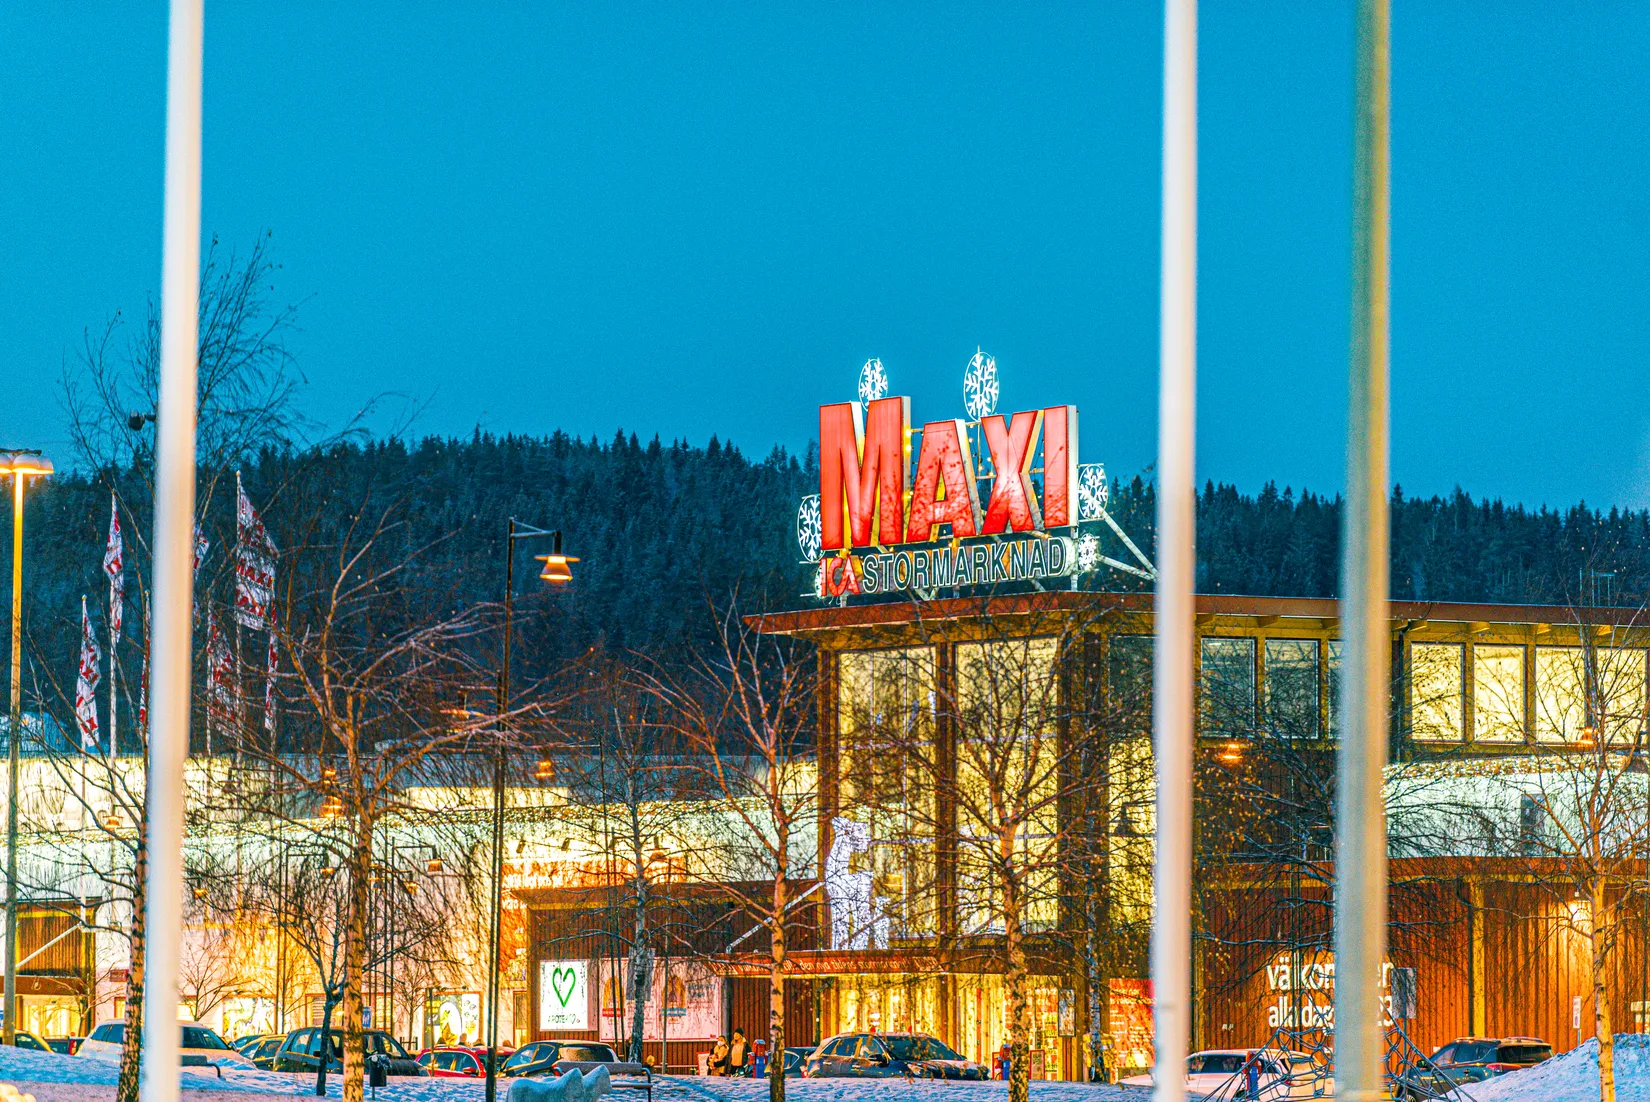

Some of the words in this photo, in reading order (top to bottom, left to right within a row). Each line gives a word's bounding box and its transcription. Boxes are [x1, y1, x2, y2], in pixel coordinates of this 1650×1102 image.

[820, 396, 1071, 550] MAXI
[820, 555, 861, 597] ICA
[862, 537, 1067, 593] STORMARKNAD
[1268, 996, 1300, 1028] alla
